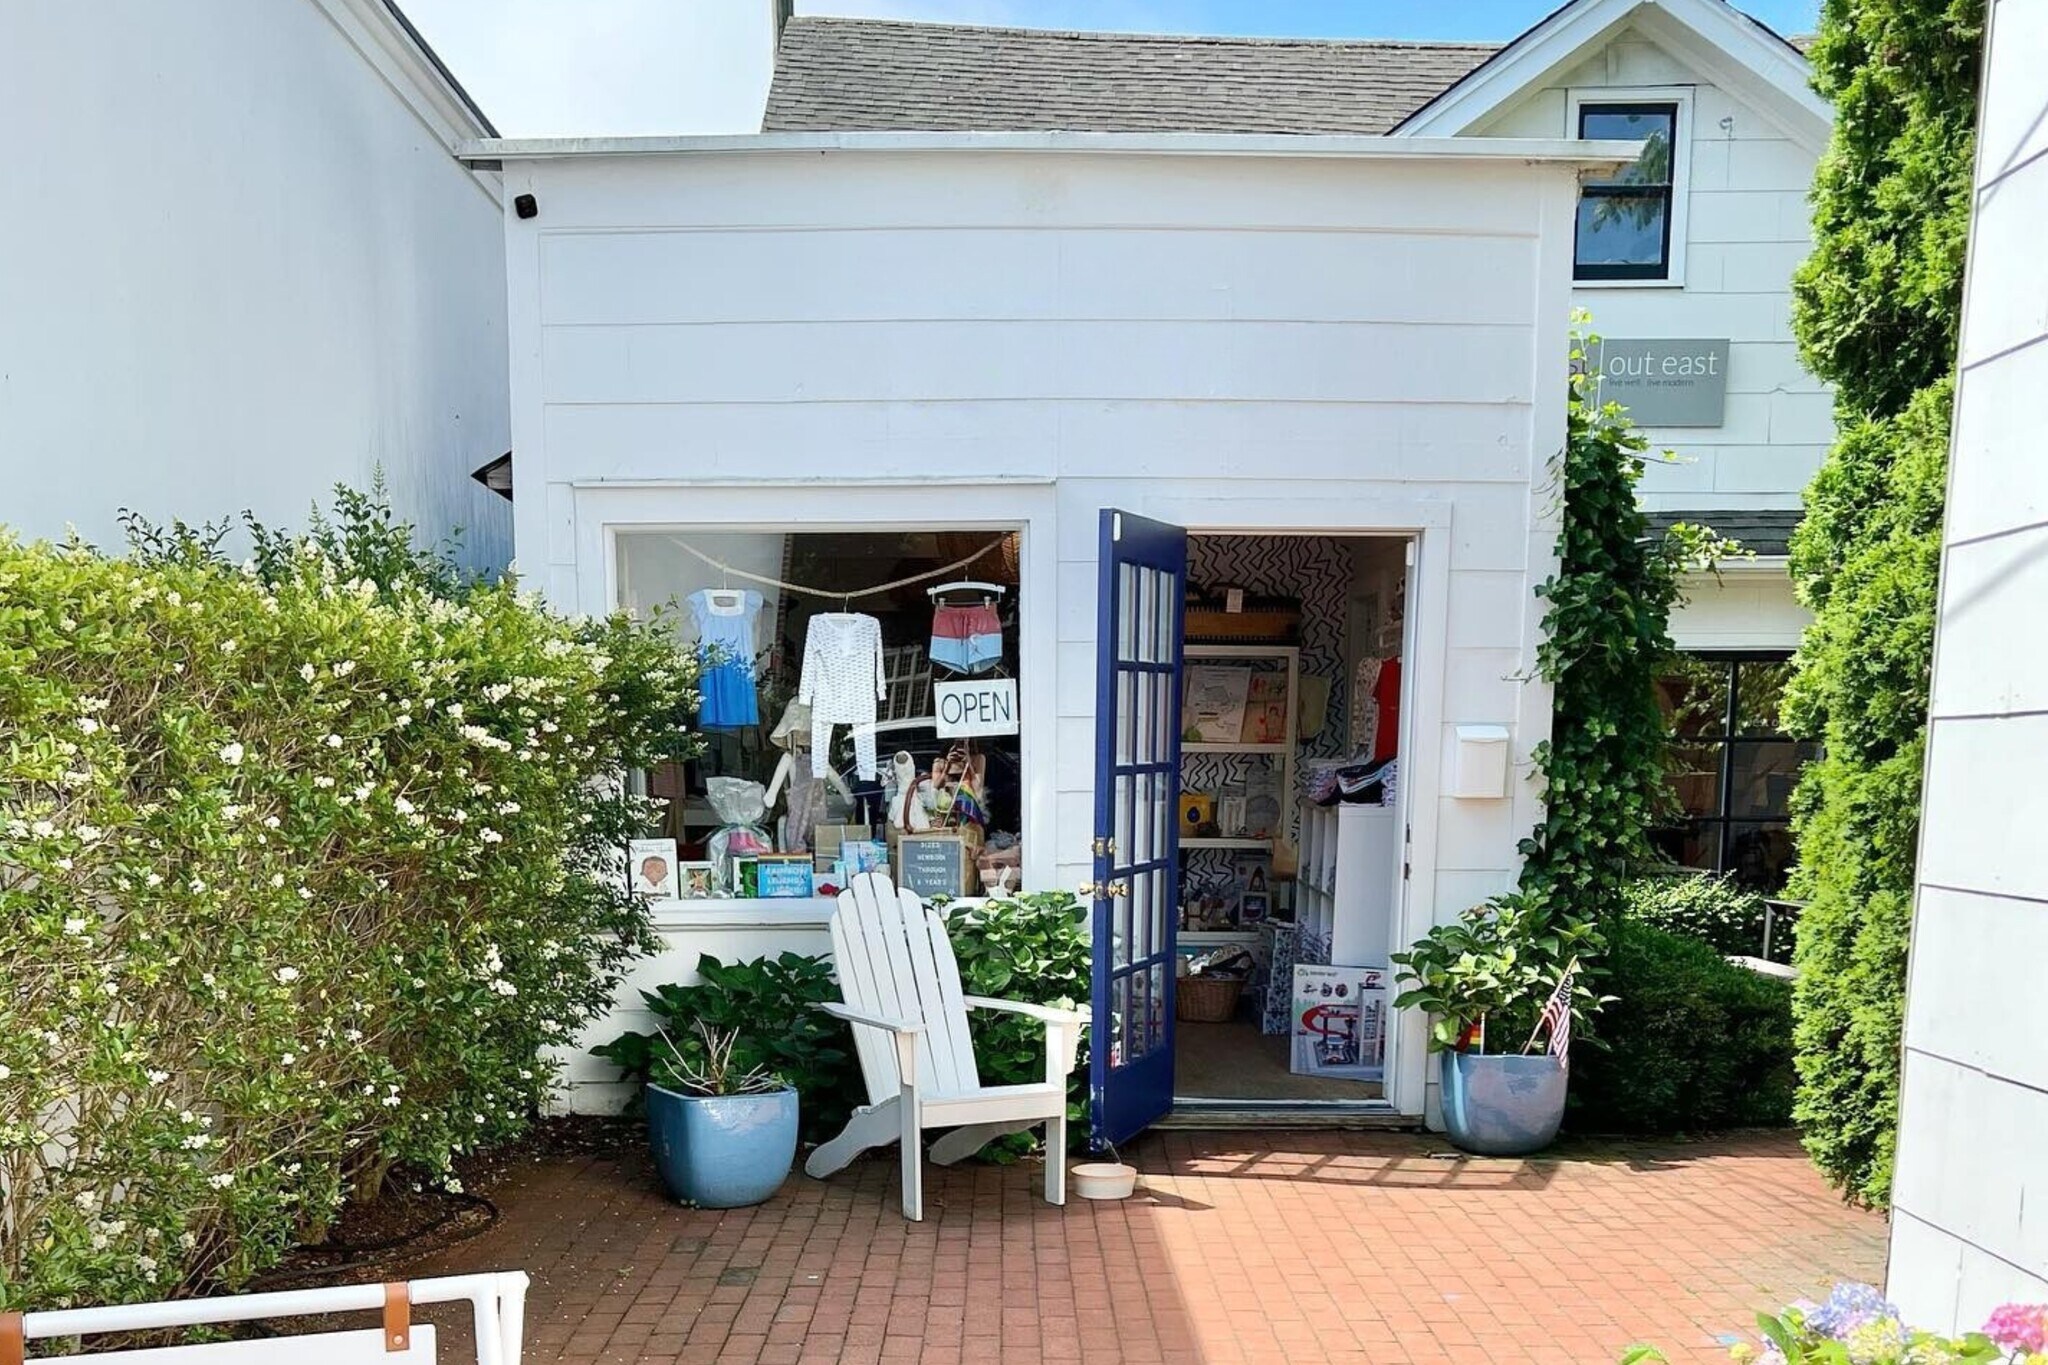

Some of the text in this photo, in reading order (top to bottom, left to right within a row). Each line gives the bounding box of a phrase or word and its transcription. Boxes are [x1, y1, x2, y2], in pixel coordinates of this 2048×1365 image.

[1609, 351, 1719, 376] out east
[941, 691, 1010, 724] OPEN
[924, 878, 947, 886] YEARS
